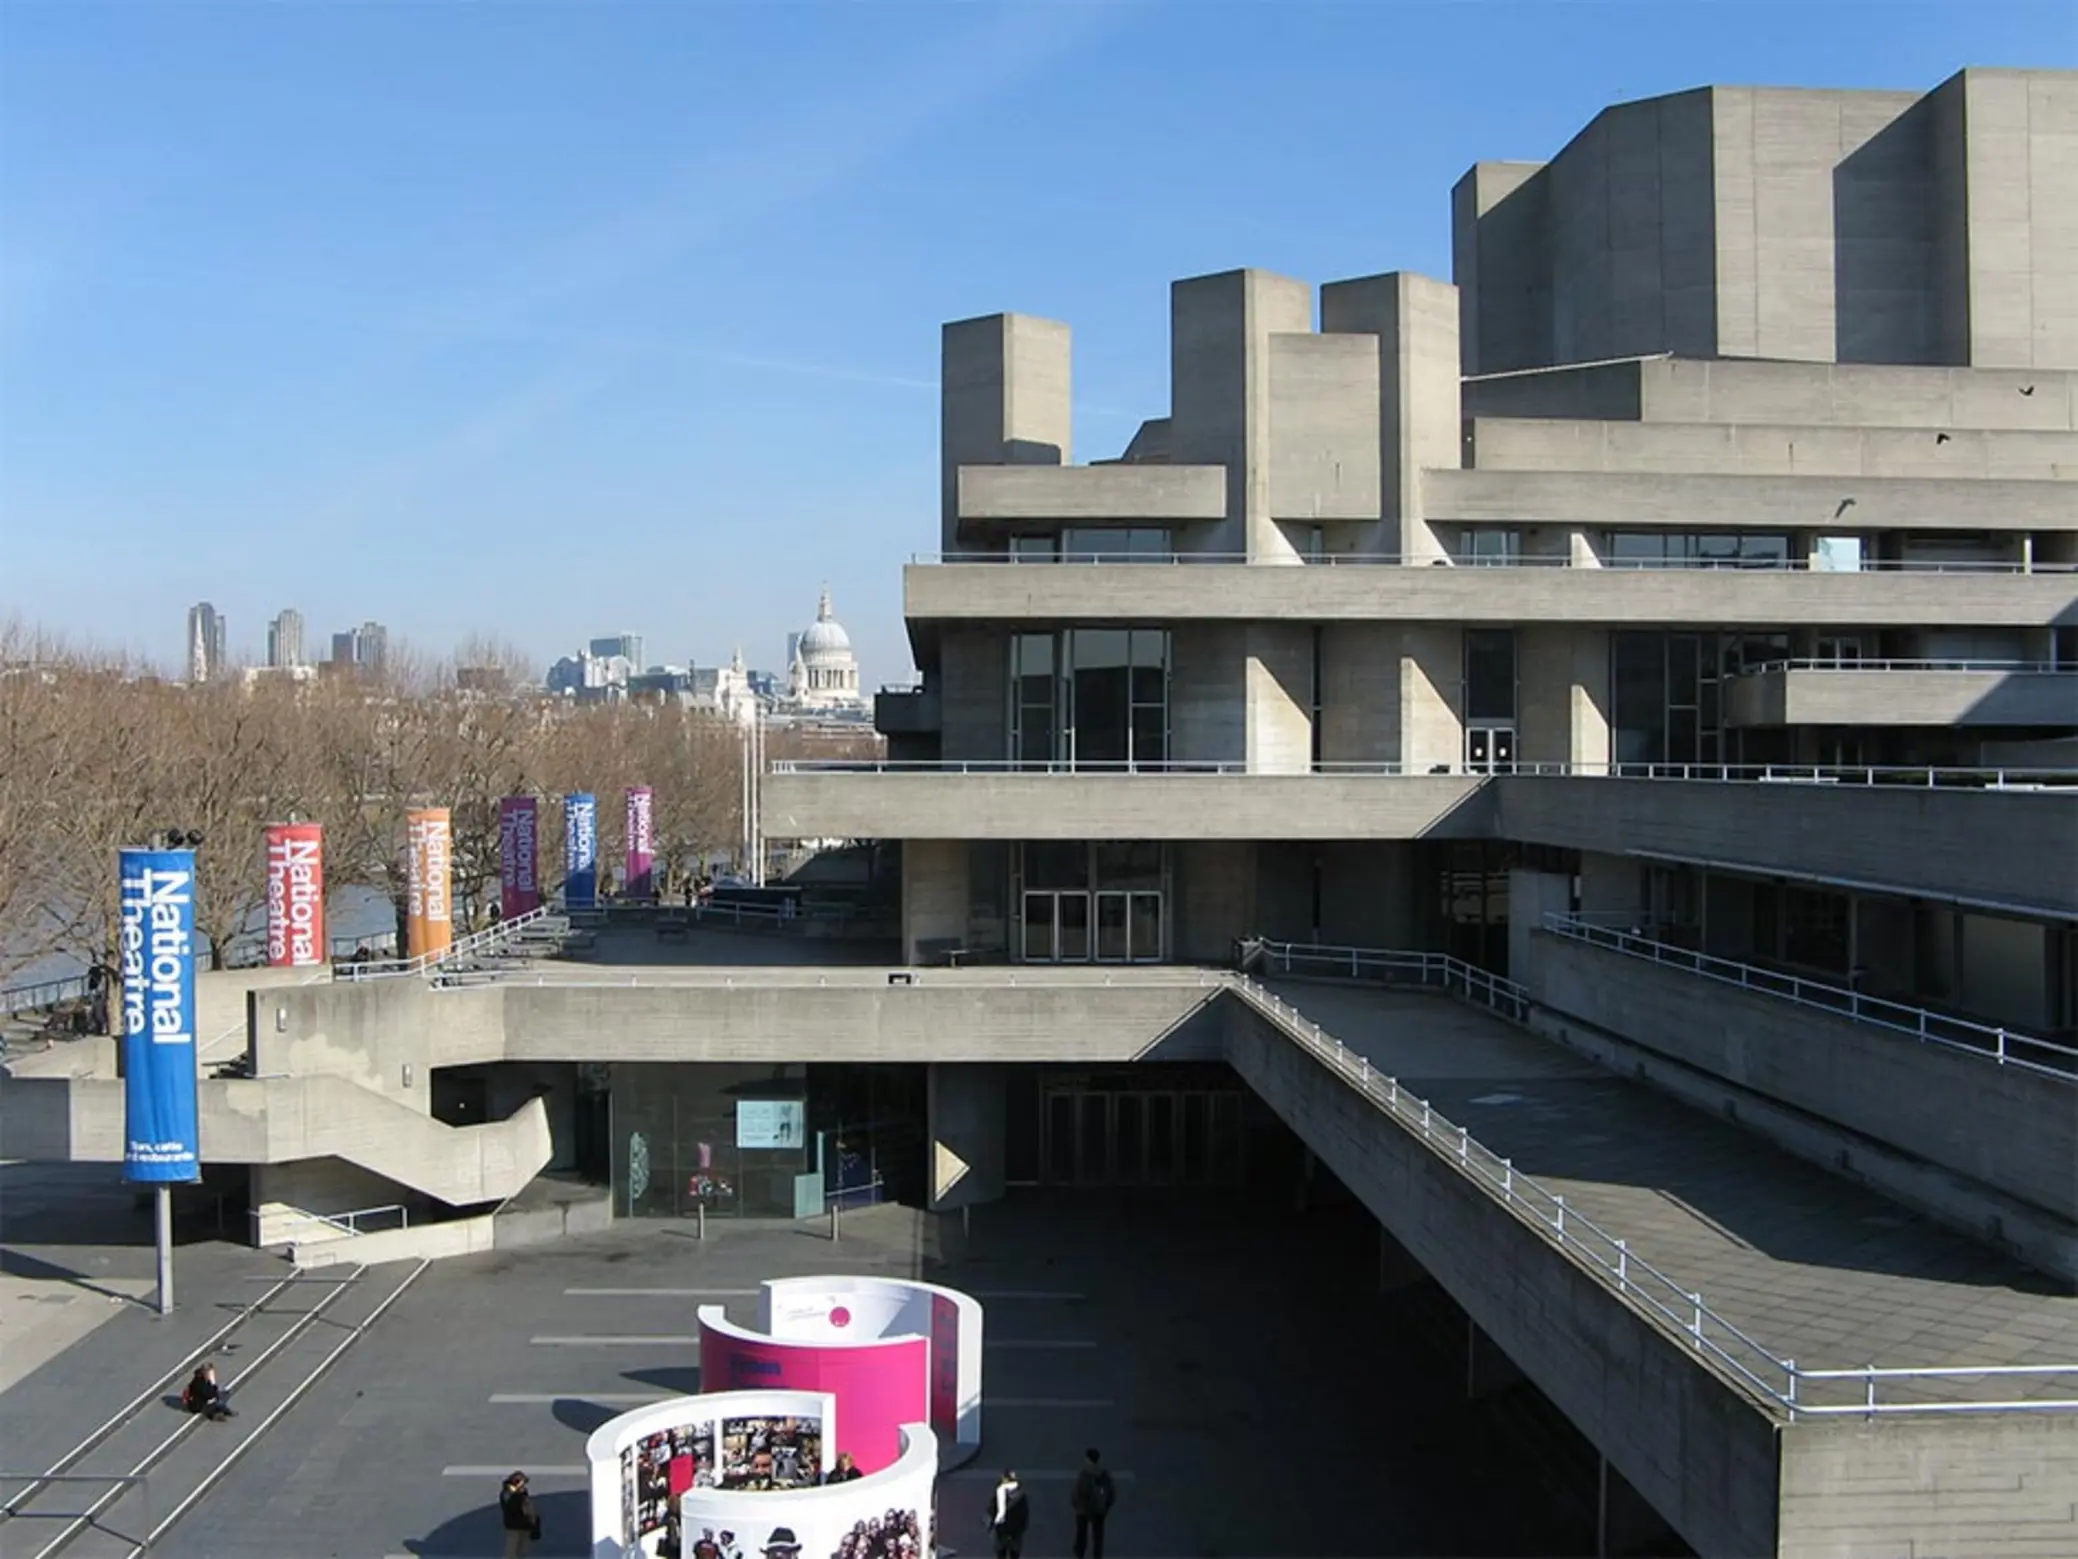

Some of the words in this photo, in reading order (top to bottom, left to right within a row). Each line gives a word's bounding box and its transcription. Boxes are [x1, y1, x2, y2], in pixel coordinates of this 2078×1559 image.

[268, 838, 292, 960] Theatre
[290, 840, 320, 965] National
[408, 820, 427, 917] Theatre
[426, 821, 450, 921] National
[502, 808, 518, 887] Theatre
[517, 809, 535, 892] National
[123, 867, 152, 1036] Theatre
[150, 871, 192, 1044] National
